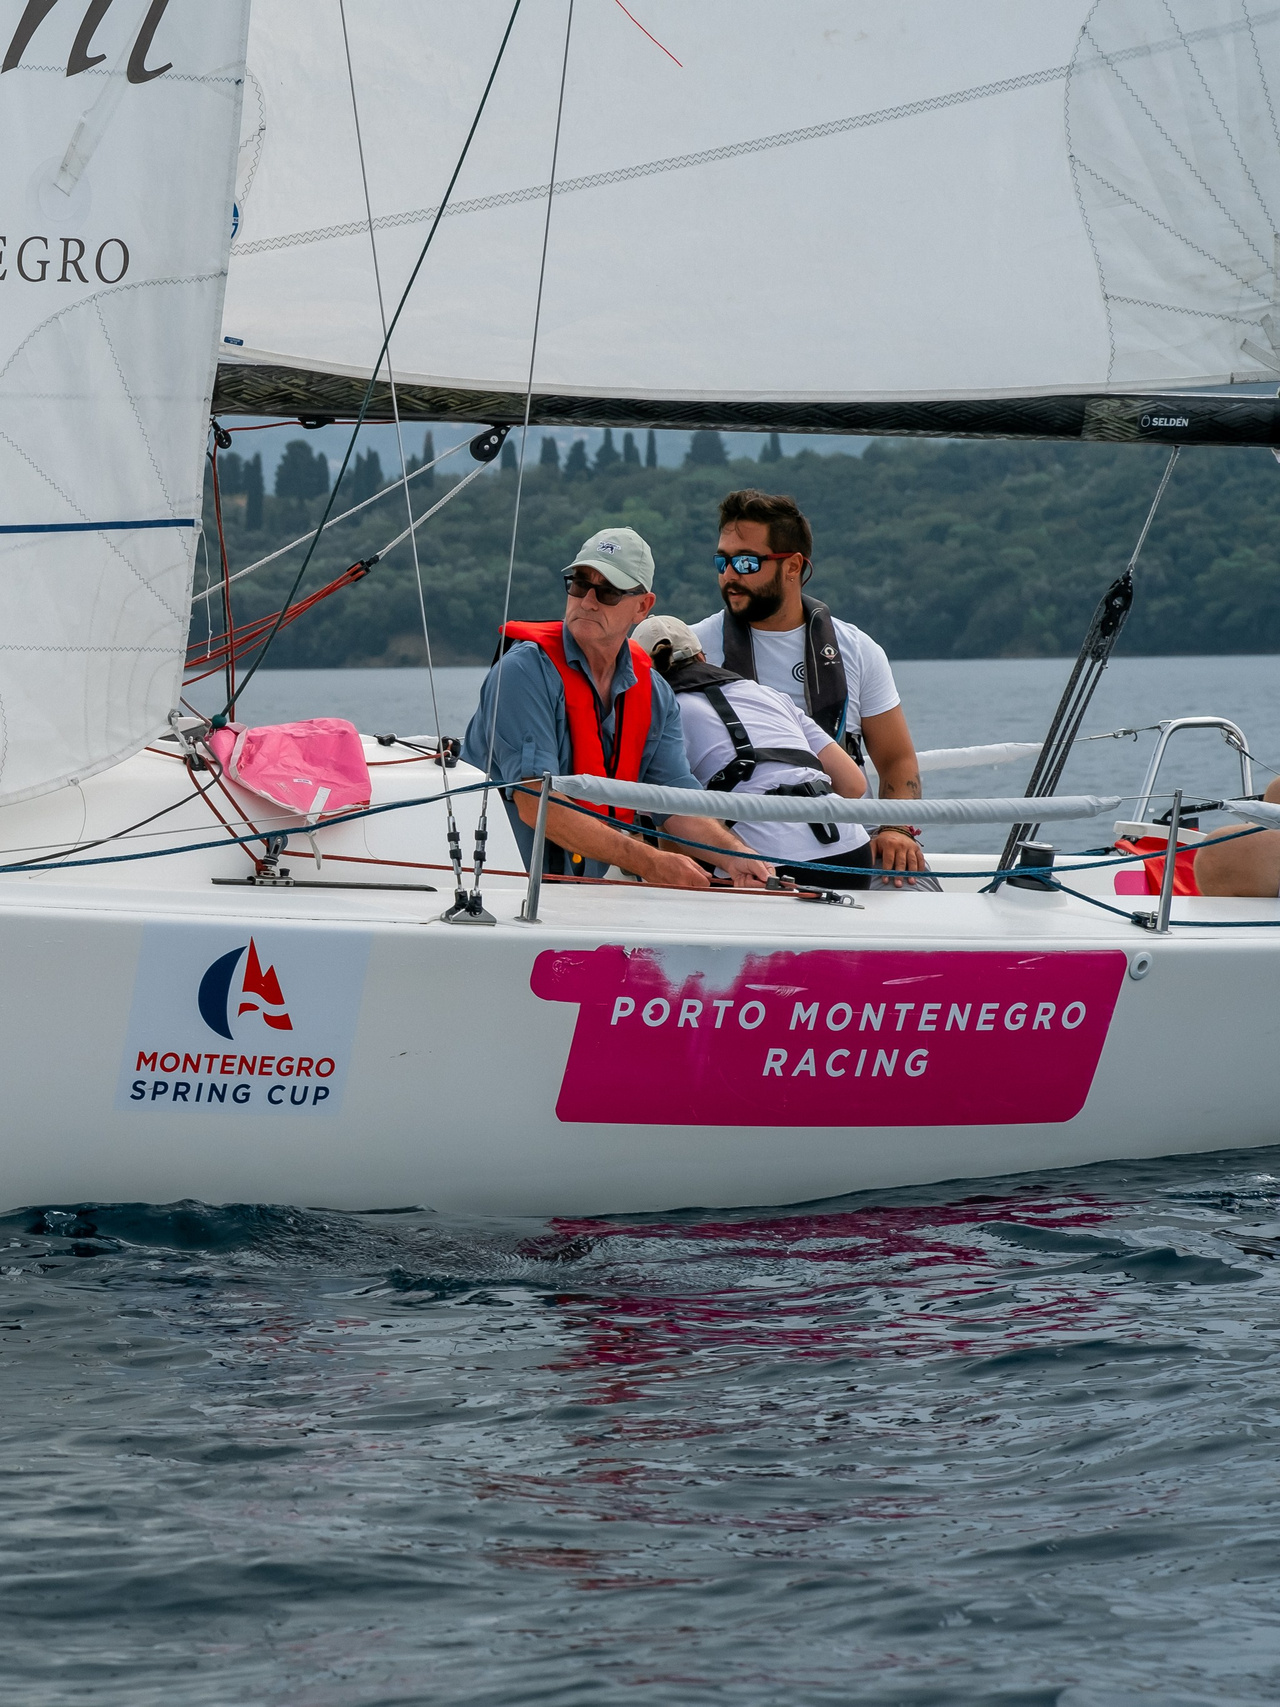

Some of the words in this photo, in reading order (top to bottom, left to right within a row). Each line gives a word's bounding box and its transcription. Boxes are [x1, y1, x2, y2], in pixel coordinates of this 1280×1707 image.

[1151, 416, 1189, 427] SELDÉN
[610, 996, 766, 1030] PORTO
[789, 1001, 1086, 1032] MONTENEGRO
[135, 1051, 336, 1078] MONTENEGRO
[762, 1048, 929, 1078] RACING
[129, 1079, 252, 1104] SPRING
[267, 1084, 330, 1106] CUP
